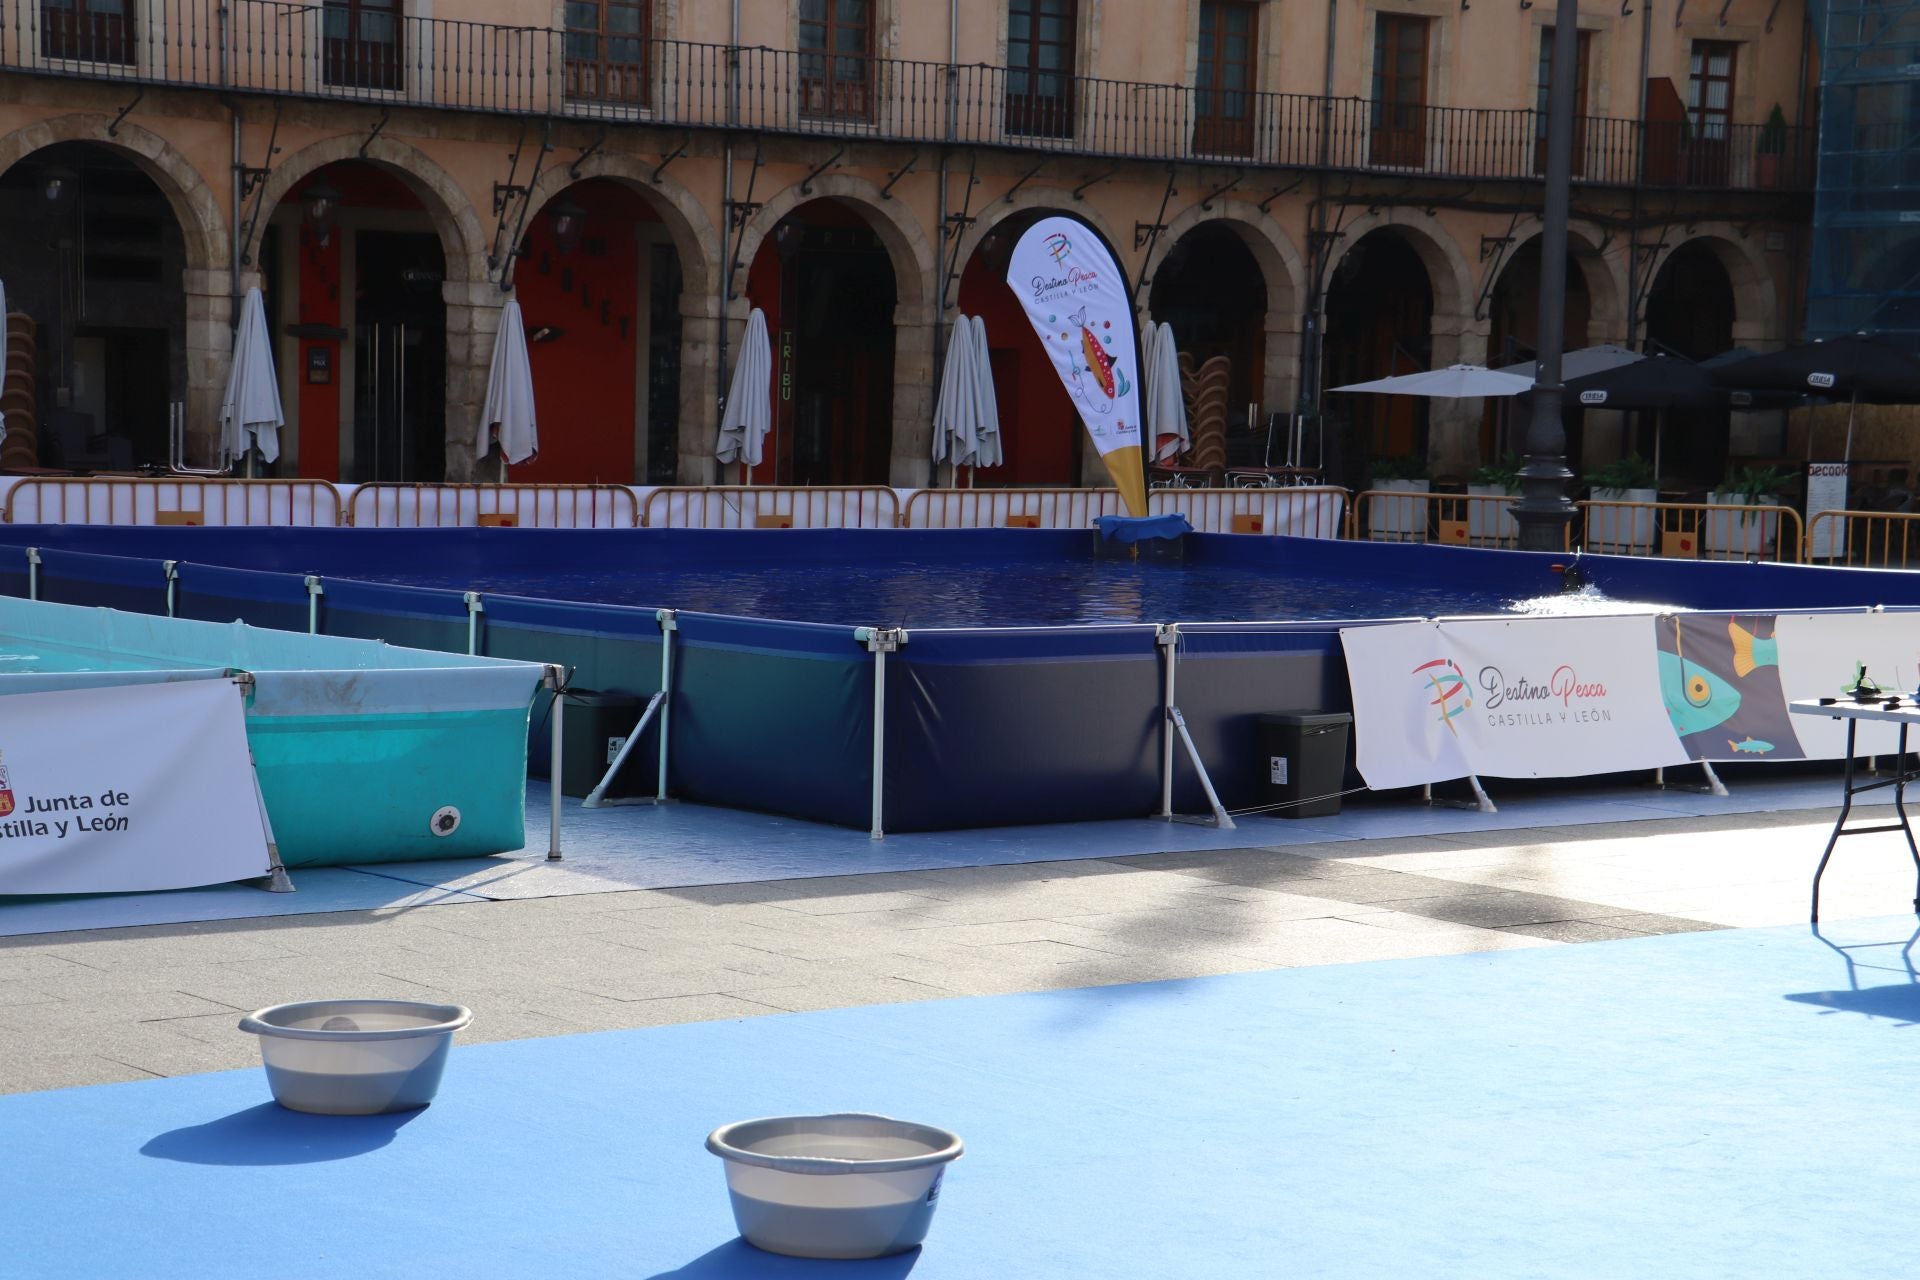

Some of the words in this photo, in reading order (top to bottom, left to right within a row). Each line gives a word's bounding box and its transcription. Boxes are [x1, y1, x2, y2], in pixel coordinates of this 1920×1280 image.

[1031, 275, 1068, 297] Destino
[1067, 267, 1098, 286] Pesca
[1034, 291, 1068, 305] CASTILLA
[1079, 283, 1100, 294] LEÓN
[782, 331, 793, 401] TRIBU
[1479, 666, 1550, 709] Destino
[1550, 665, 1607, 708] Pesca
[1487, 713, 1553, 727] CASTILLA
[1560, 712, 1567, 723] Y
[1574, 709, 1611, 723] LEÓN
[24, 795, 93, 813] Junta
[100, 790, 129, 806] de
[54, 820, 68, 838] y
[76, 813, 129, 832] León
